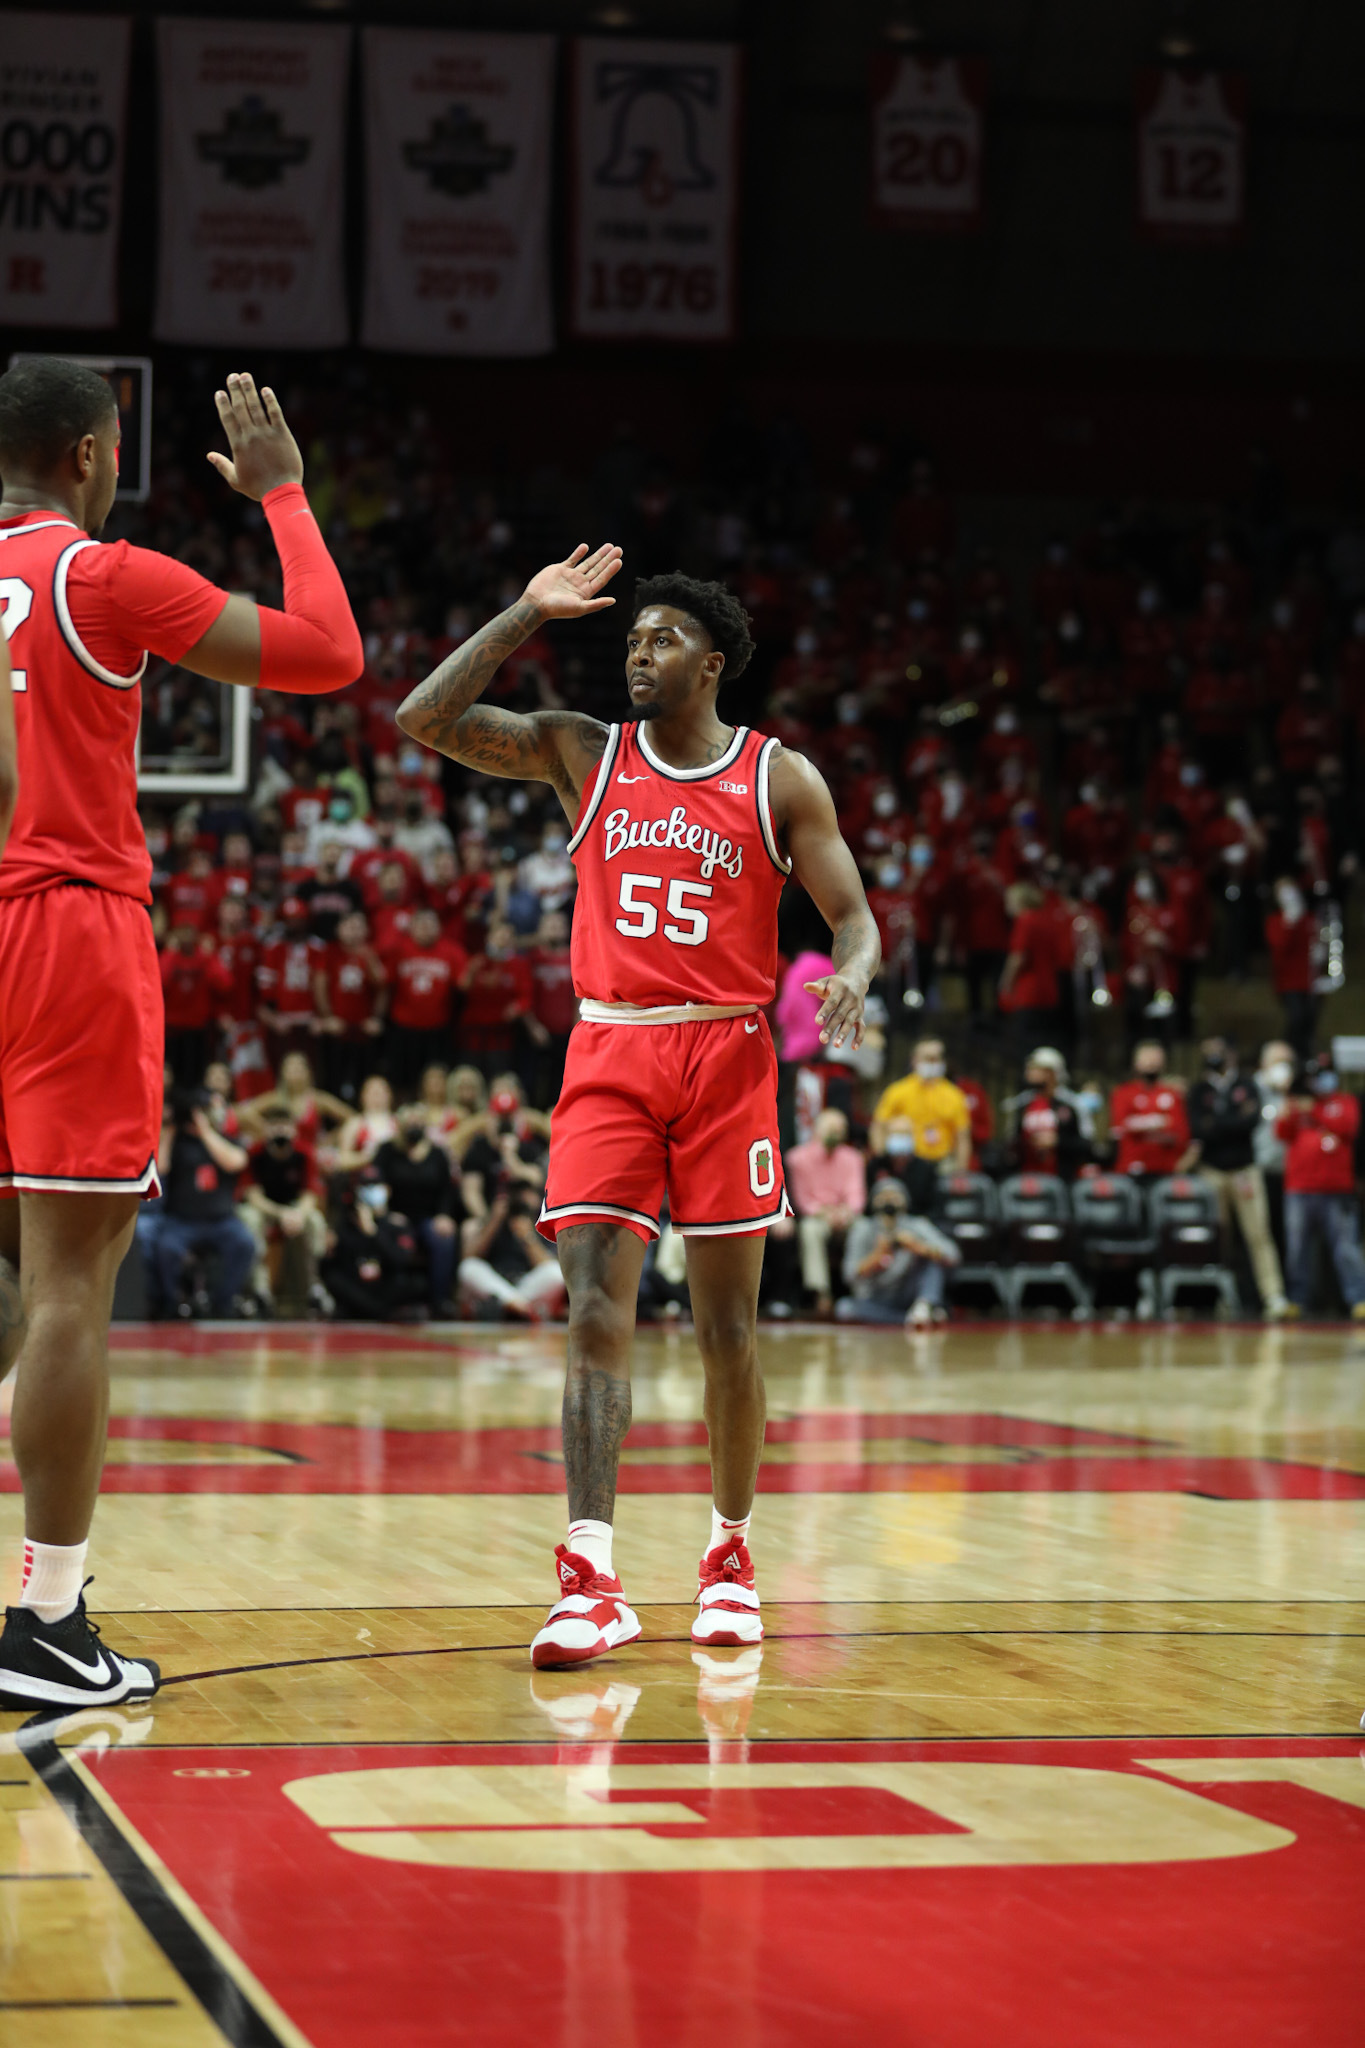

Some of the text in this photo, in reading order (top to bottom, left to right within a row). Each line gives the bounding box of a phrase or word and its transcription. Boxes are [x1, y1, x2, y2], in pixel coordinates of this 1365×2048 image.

[887, 132, 968, 186] 20
[1158, 145, 1224, 201] 12
[210, 260, 294, 291] 2019
[416, 268, 500, 299] 2019
[590, 260, 716, 312] 1976
[461, 744, 508, 763] LION
[604, 806, 743, 879] Buckeyes
[615, 872, 713, 946] 55
